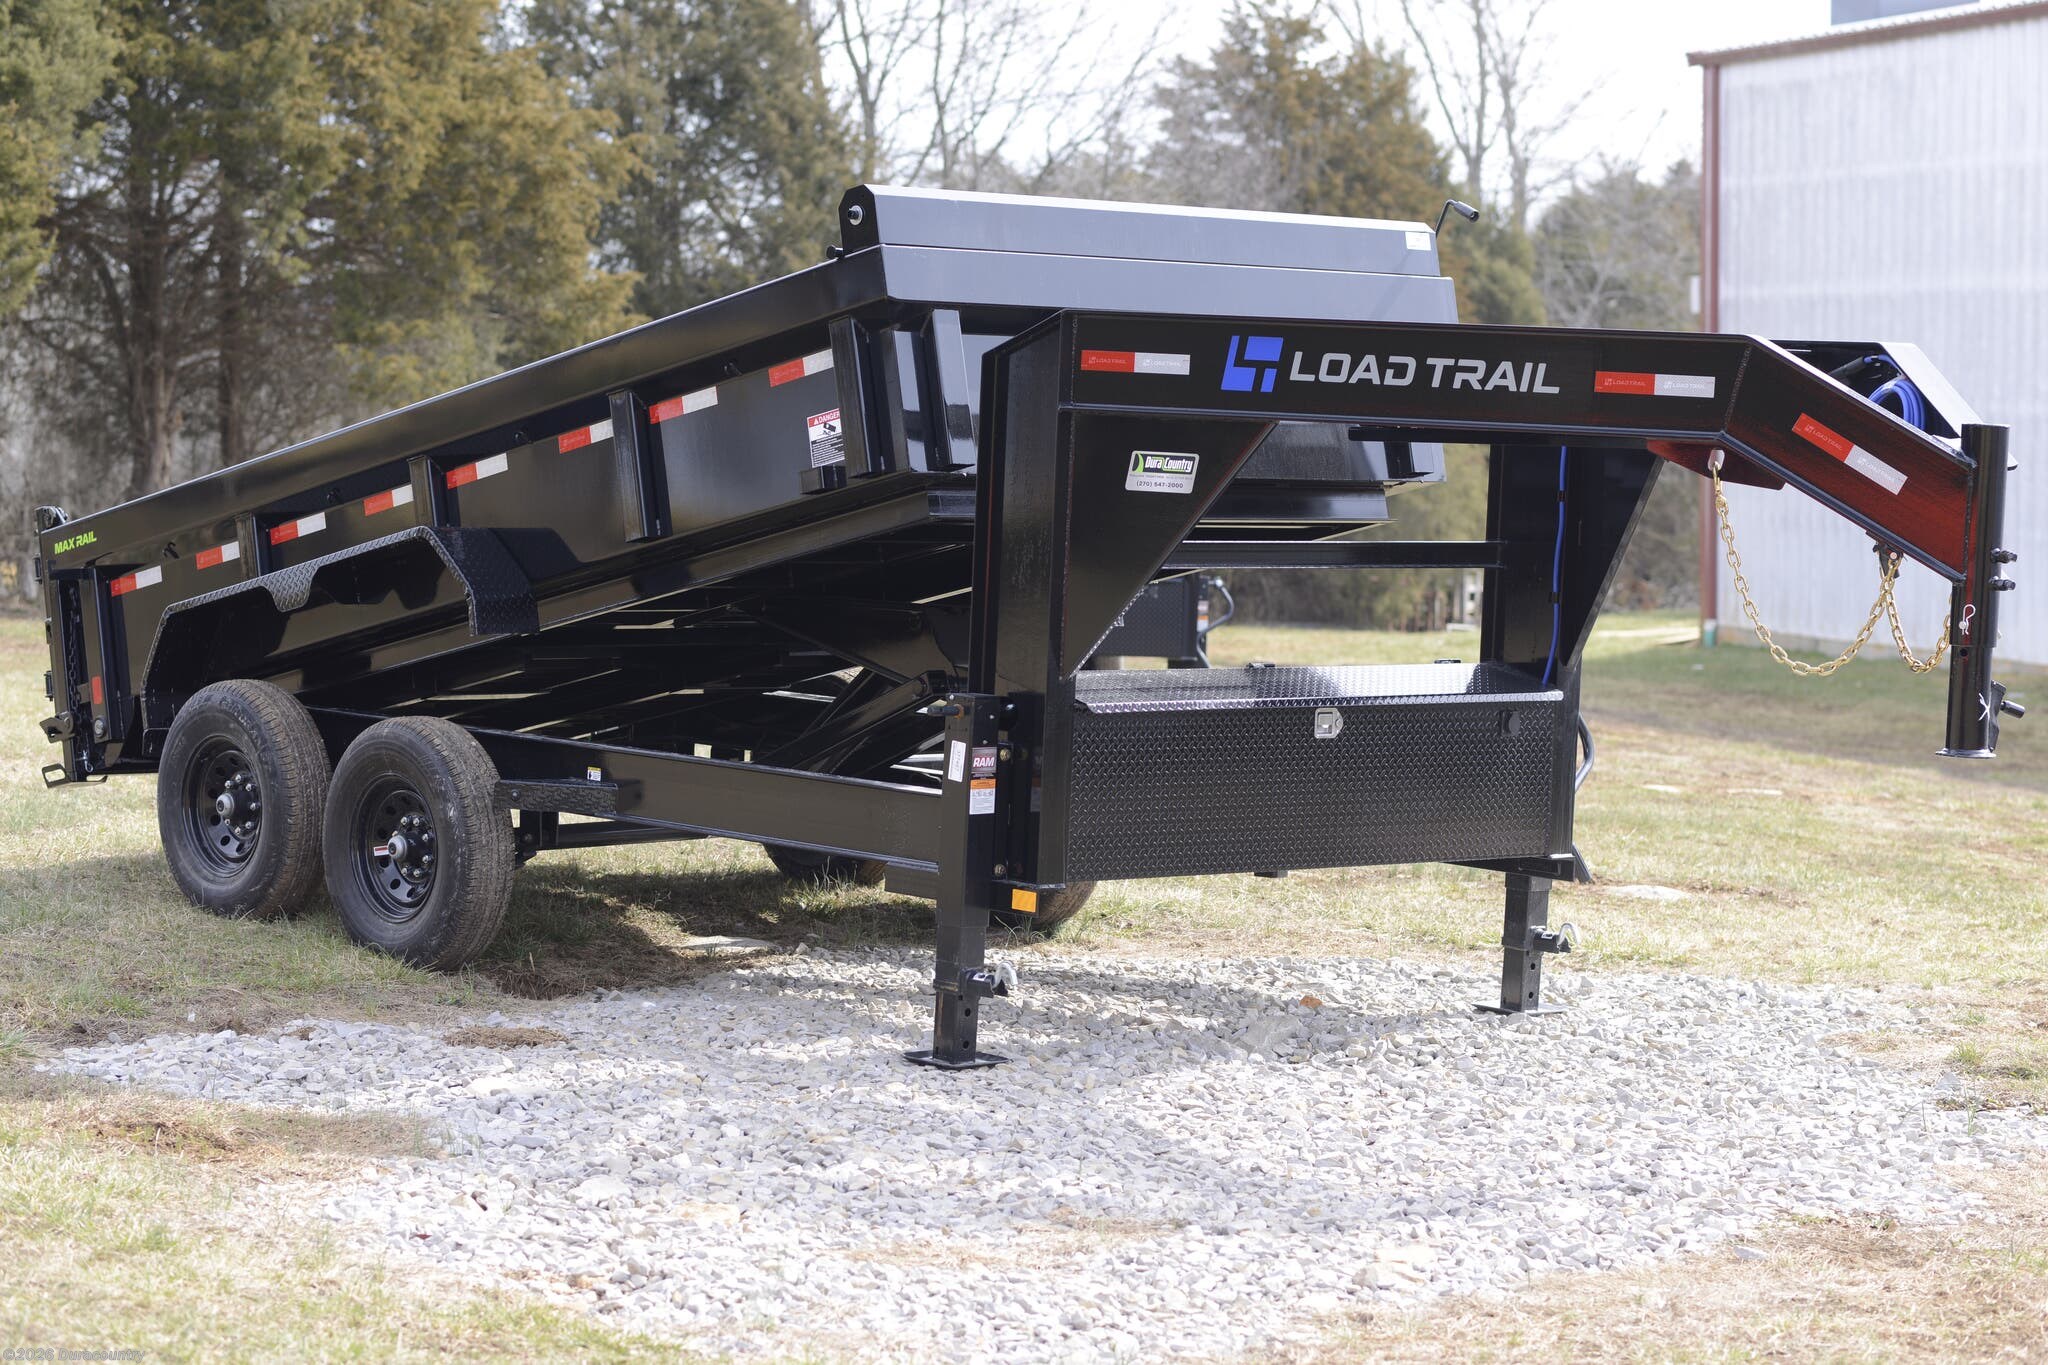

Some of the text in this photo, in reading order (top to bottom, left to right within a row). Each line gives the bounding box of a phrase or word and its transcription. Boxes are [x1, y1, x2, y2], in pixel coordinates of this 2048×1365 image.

[1289, 351, 1560, 394] LOAD TRAIL
[1144, 456, 1194, 473] Dura Country
[54, 530, 97, 555] MAX RAIL
[973, 757, 995, 768] RAM
